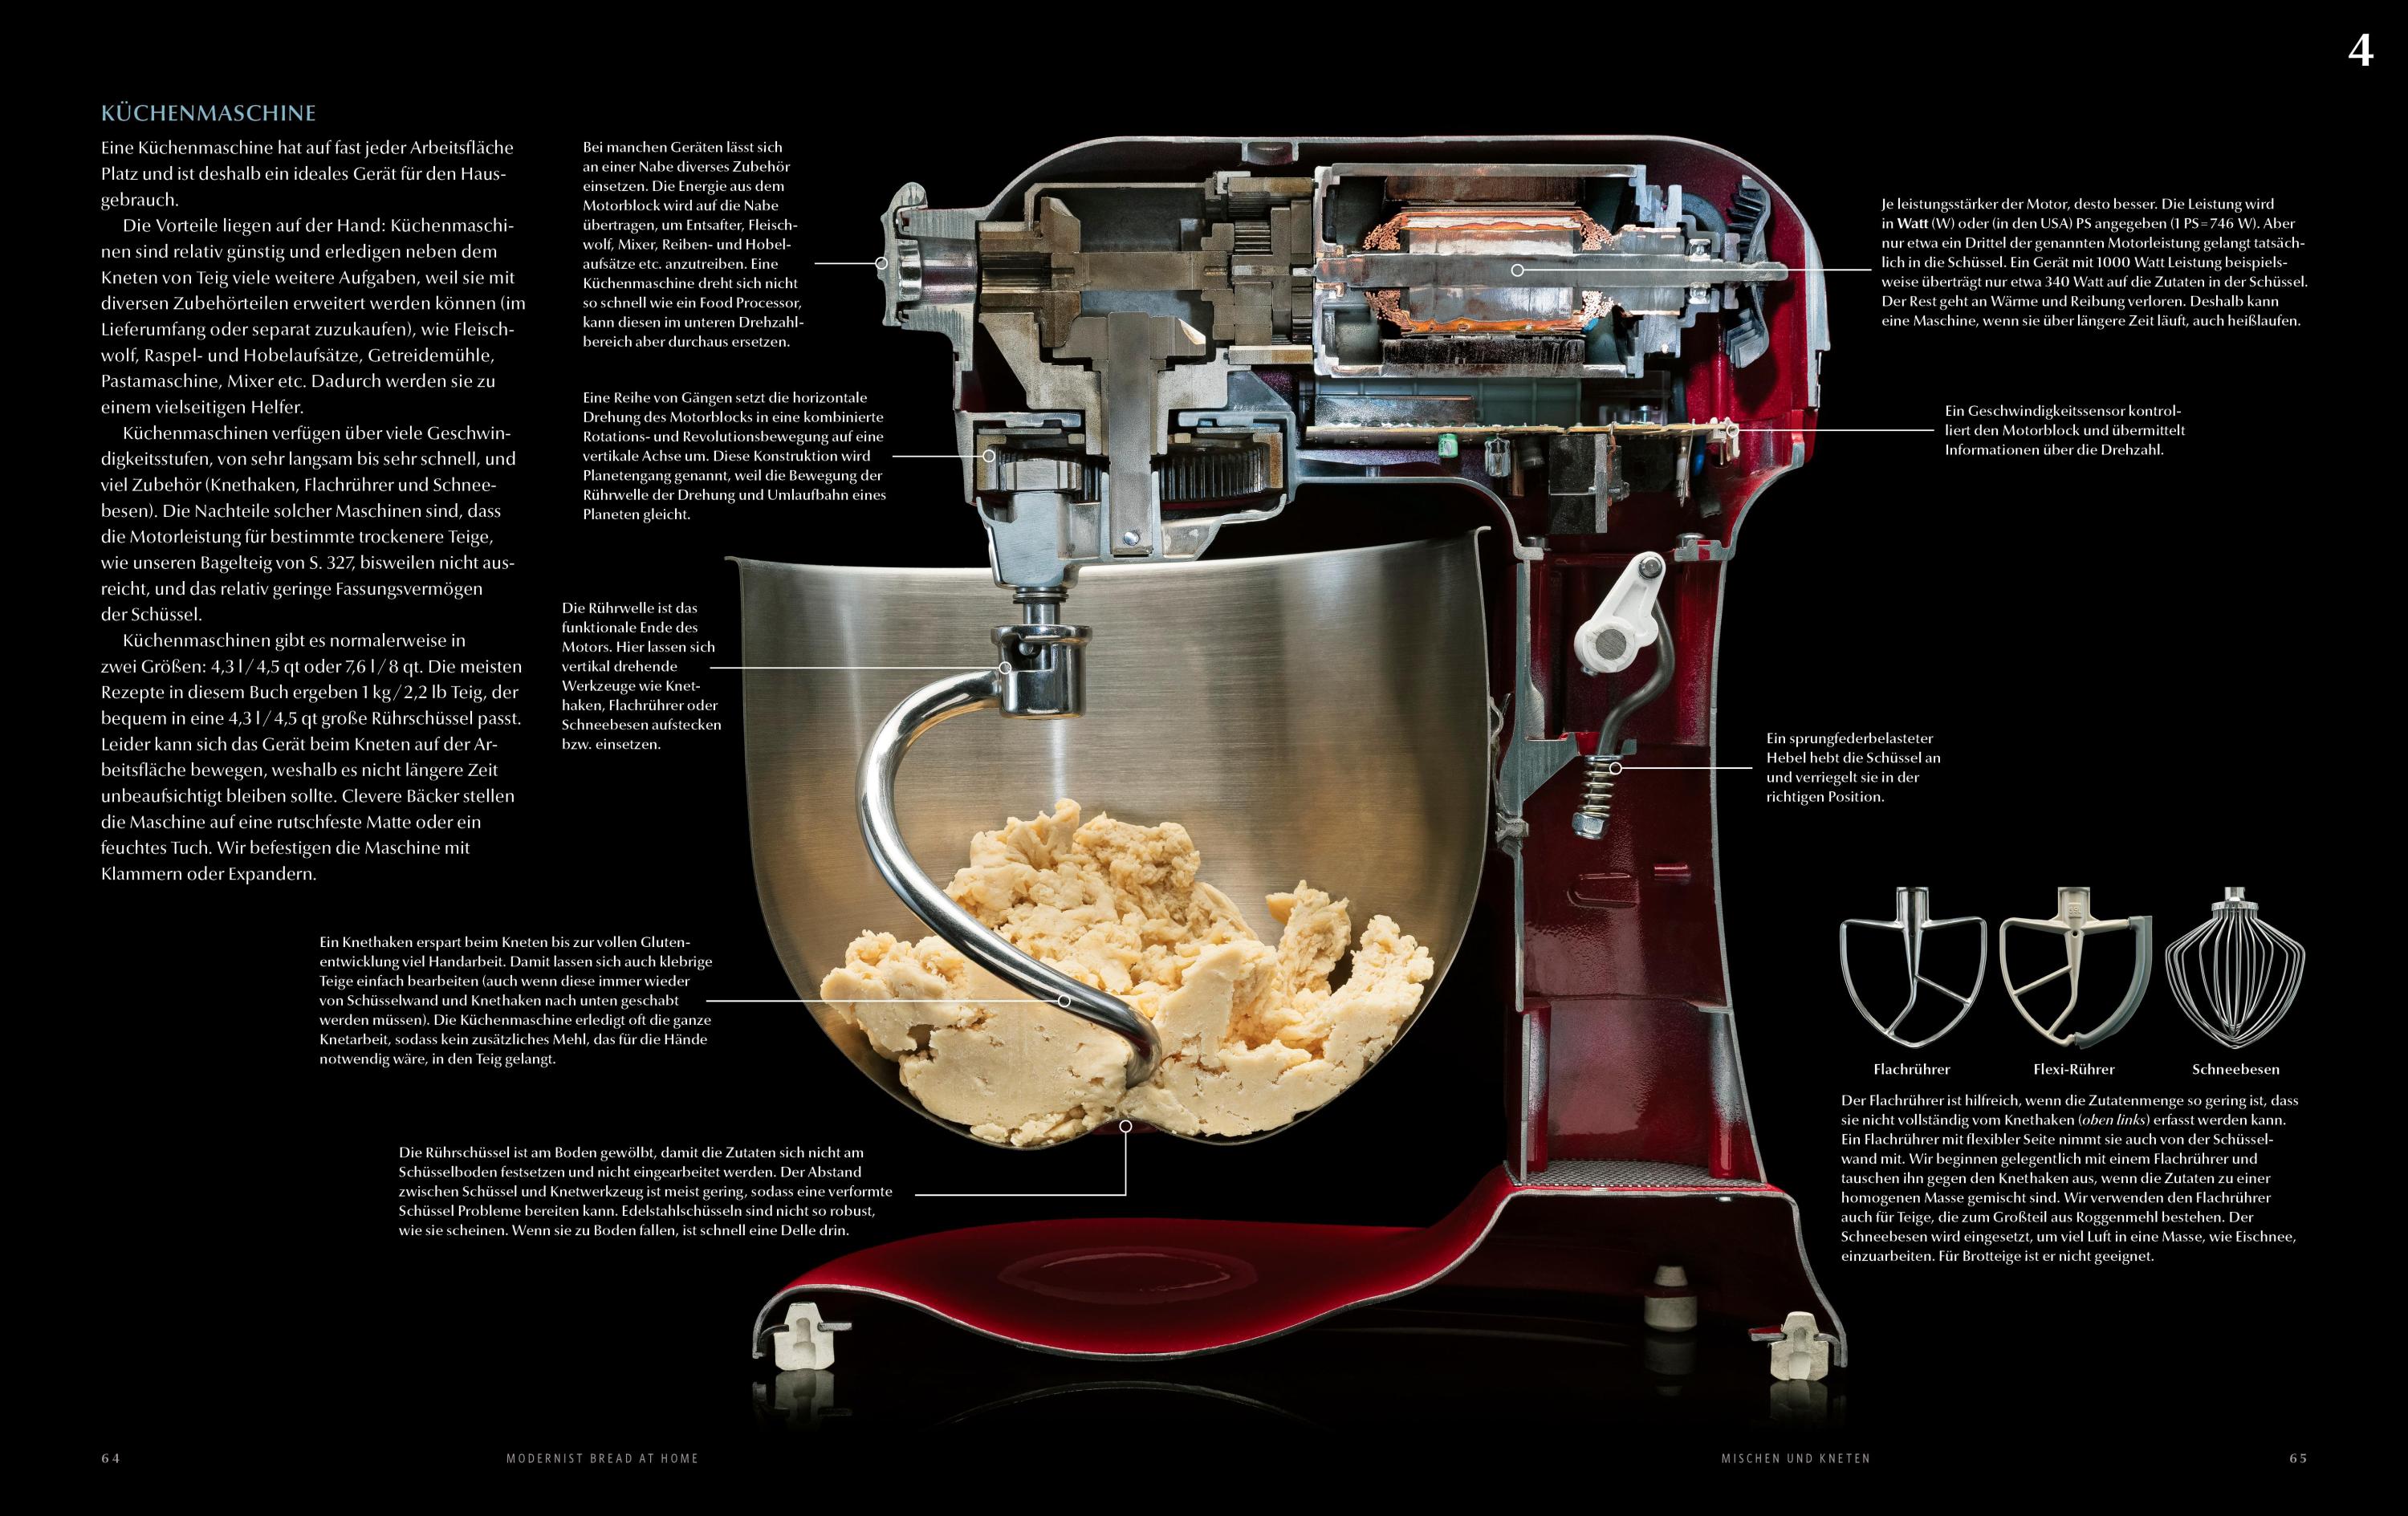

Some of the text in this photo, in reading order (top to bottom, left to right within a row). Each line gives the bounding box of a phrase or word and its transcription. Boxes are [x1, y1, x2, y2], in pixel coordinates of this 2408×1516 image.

[2348, 33, 2374, 67] 4
[102, 100, 315, 122] KÜCHENMASCHINE
[584, 140, 783, 153] Bei manchen Geräten lässt sich
[102, 165, 506, 181] Platz und ist deshalb ein ideales Gerät für den Haus-
[583, 179, 784, 196] einsetzen. Die Energie aus dem
[100, 191, 179, 211] gebrauch.
[1881, 197, 2275, 213] Je leistungsstärker der Motor, desto besser. Die Leistung wird
[101, 243, 497, 263] nen sind relativ günstig und erledigen neben dem
[584, 276, 799, 289] Küchenmaschine dreht sich nicht
[1881, 314, 2301, 331] eine Maschine, wenn sie über längere Zeit läuft, auch heißlaufen.
[584, 391, 868, 408] Eine Reihe von Gängen setzt die horizontale
[101, 398, 303, 419] einem vielseitigen Helfer.
[1946, 404, 2182, 421] Ein Geschwindigkeitssensor kontrol-
[1945, 423, 2186, 437] liert den Motorblock und übermittelt
[584, 507, 691, 524] Planeten gleicht.
[101, 580, 482, 600] reicht, und das relativ geringe Fassungsvermögen
[562, 601, 698, 614] Die Rührwelle ist das
[124, 632, 466, 652] Küchenmaschinen gibt es normalerweise in
[562, 679, 701, 696] Werkzeuge wie Knet-
[562, 738, 661, 750] bzw. einsetzen.
[1767, 731, 1934, 748] Ein sprungfederbelasteter
[1767, 790, 1885, 807] richtigen Position.
[100, 839, 471, 860] feuchtes Tuch. Wir befestigen die Maschine mit
[102, 865, 316, 885] Klammern oder Expandern.
[319, 1013, 712, 1030] werden müssen). Die Küchenmaschine erledigt oft die ganze
[1874, 1063, 1951, 1075] Flachrührer
[2034, 1063, 2116, 1075] Flexi-Rührer
[2192, 1063, 2280, 1075] Schneebesen
[1841, 1152, 2258, 1168] wand mit. Wir beginnen gelegentlich mit einem Flachrührer und
[398, 1204, 876, 1218] Schüssel Probleme bereiten kann. Edelstahlschüsseln sind nicht so robust,
[1841, 1249, 2154, 1266] einzuarbeiten. Für Brotteige ist er nicht geeignet.
[101, 1453, 120, 1464] 64
[506, 1453, 698, 1464] MODERNIST BREAD AT HOME
[1722, 1453, 1869, 1464] MISCHEN UND KNETEN
[2289, 1453, 2307, 1464] 65
